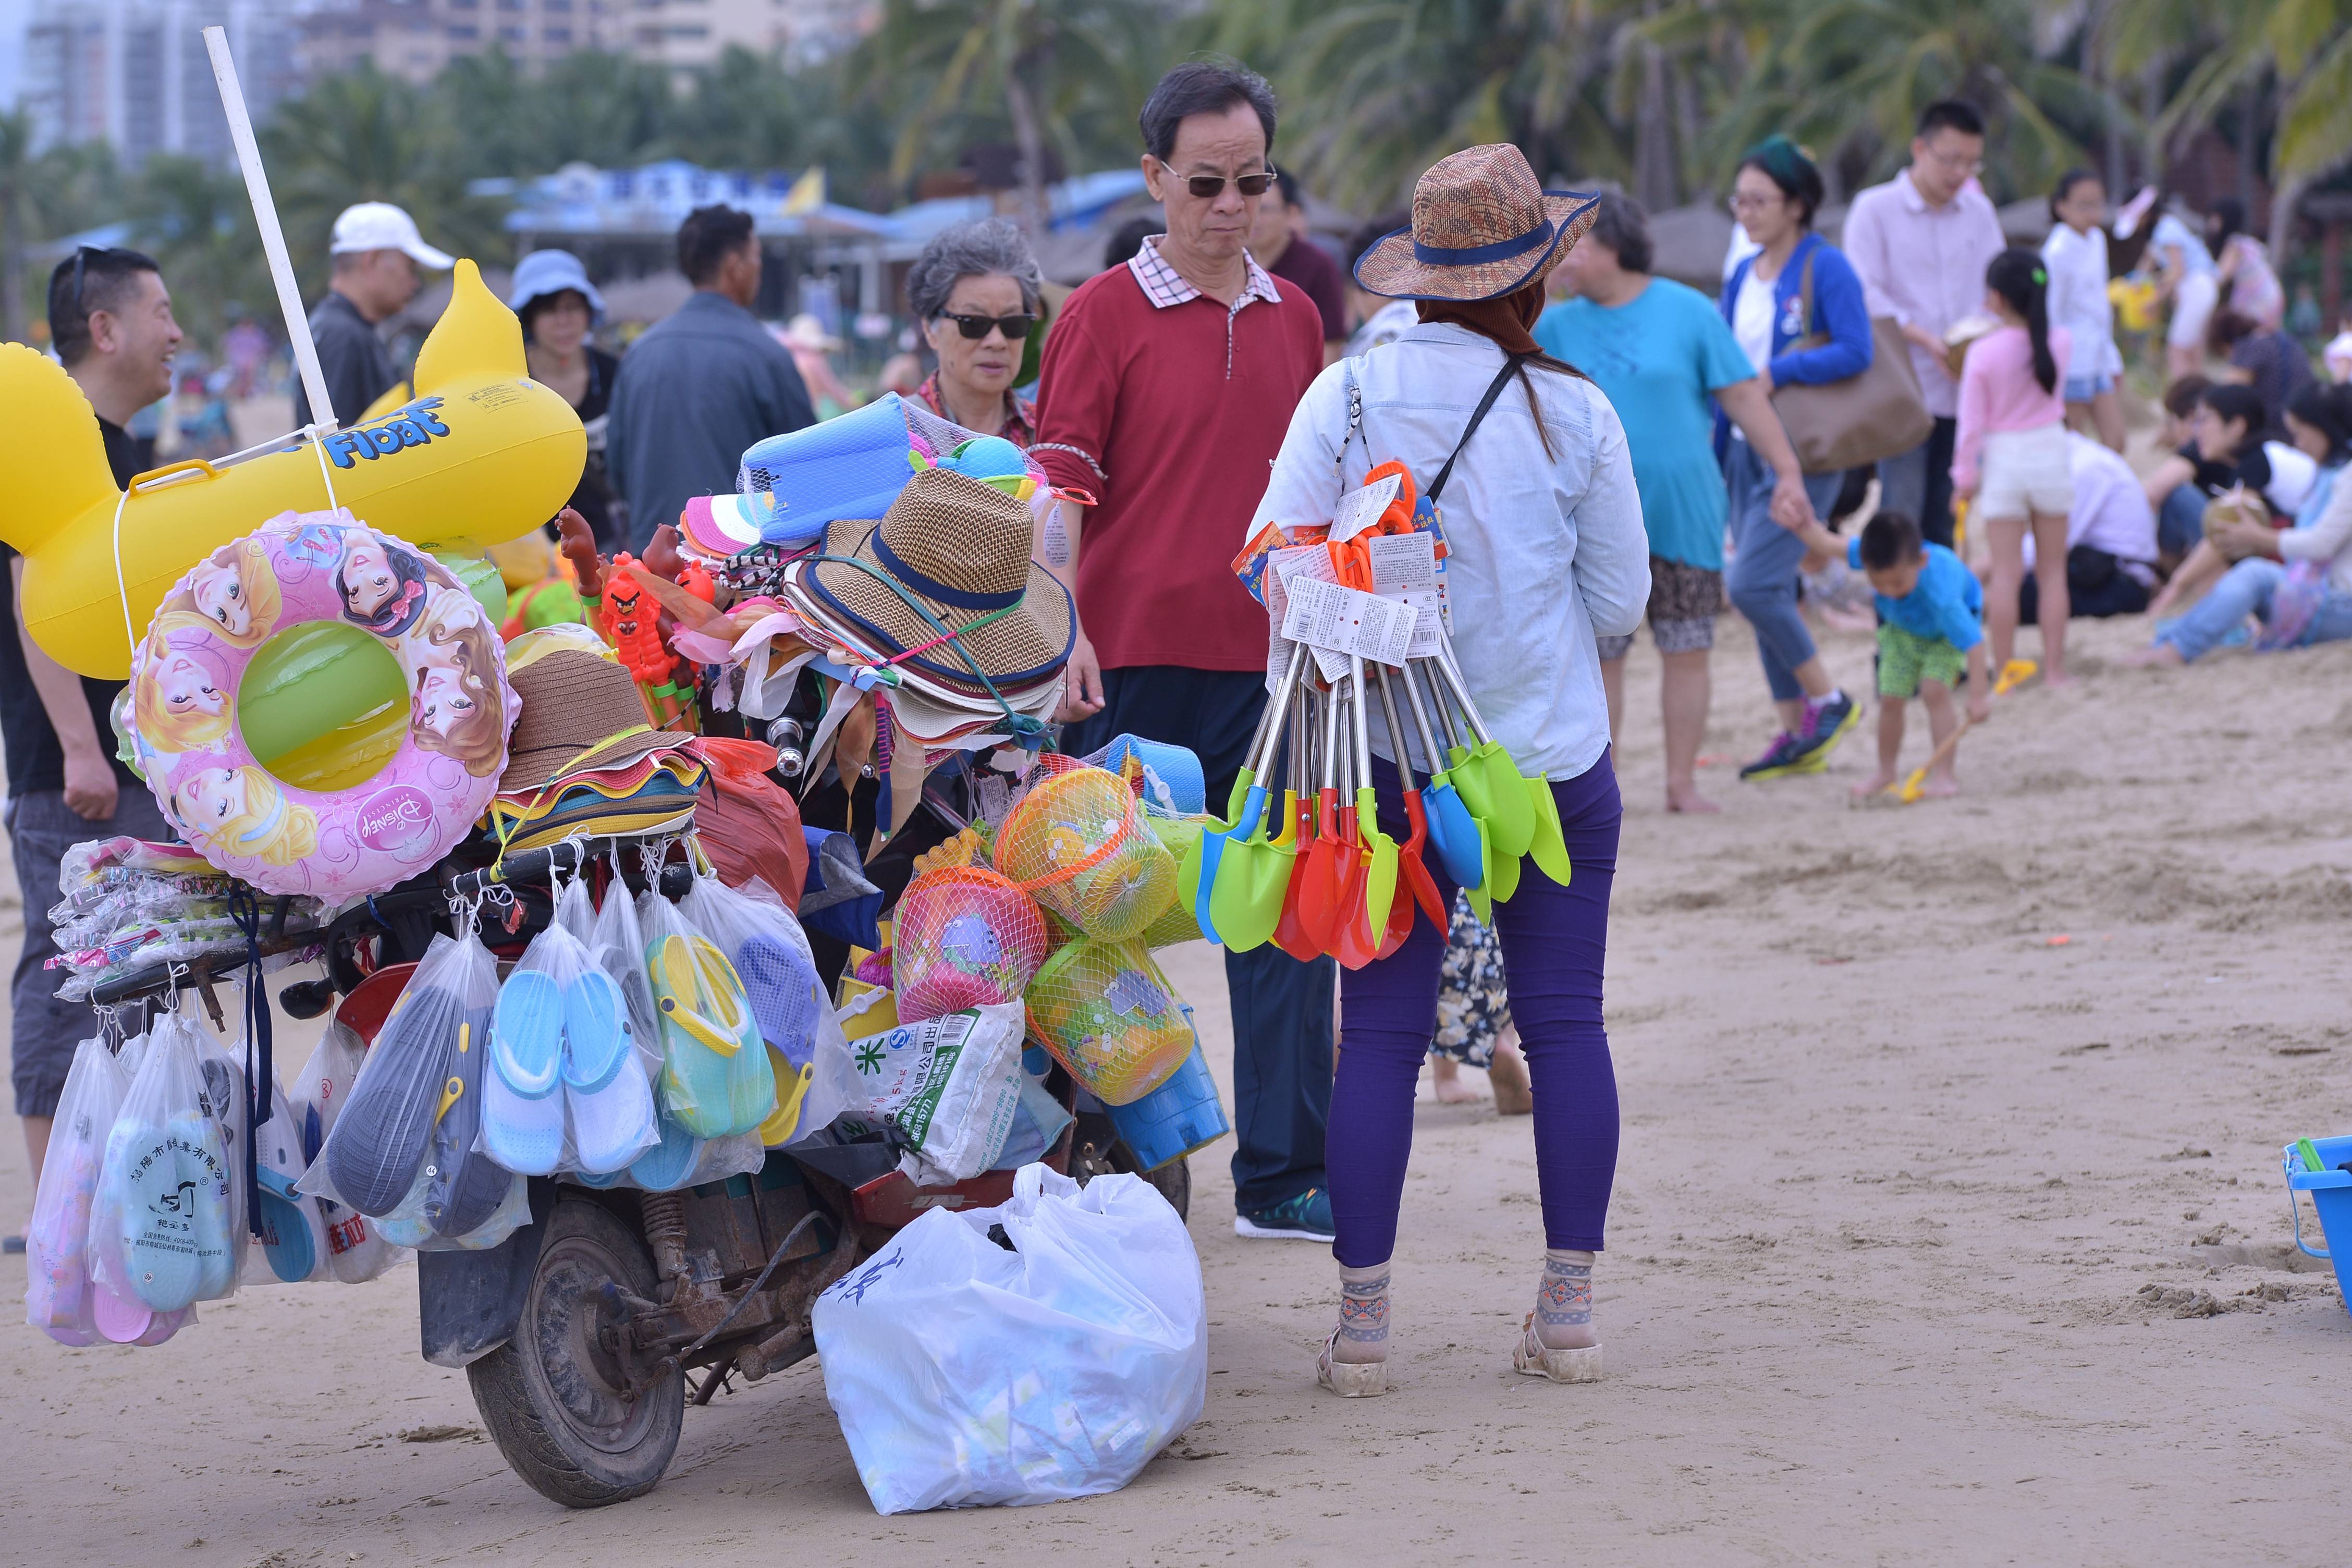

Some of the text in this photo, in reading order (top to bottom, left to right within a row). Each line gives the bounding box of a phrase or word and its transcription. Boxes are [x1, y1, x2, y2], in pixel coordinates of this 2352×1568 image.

[322, 409, 450, 469] Float
[1314, 585, 1322, 608] 产品合格证
[368, 794, 405, 819] PRINCESS
[855, 1037, 886, 1076] 米
[911, 1099, 932, 1142] 86815777
